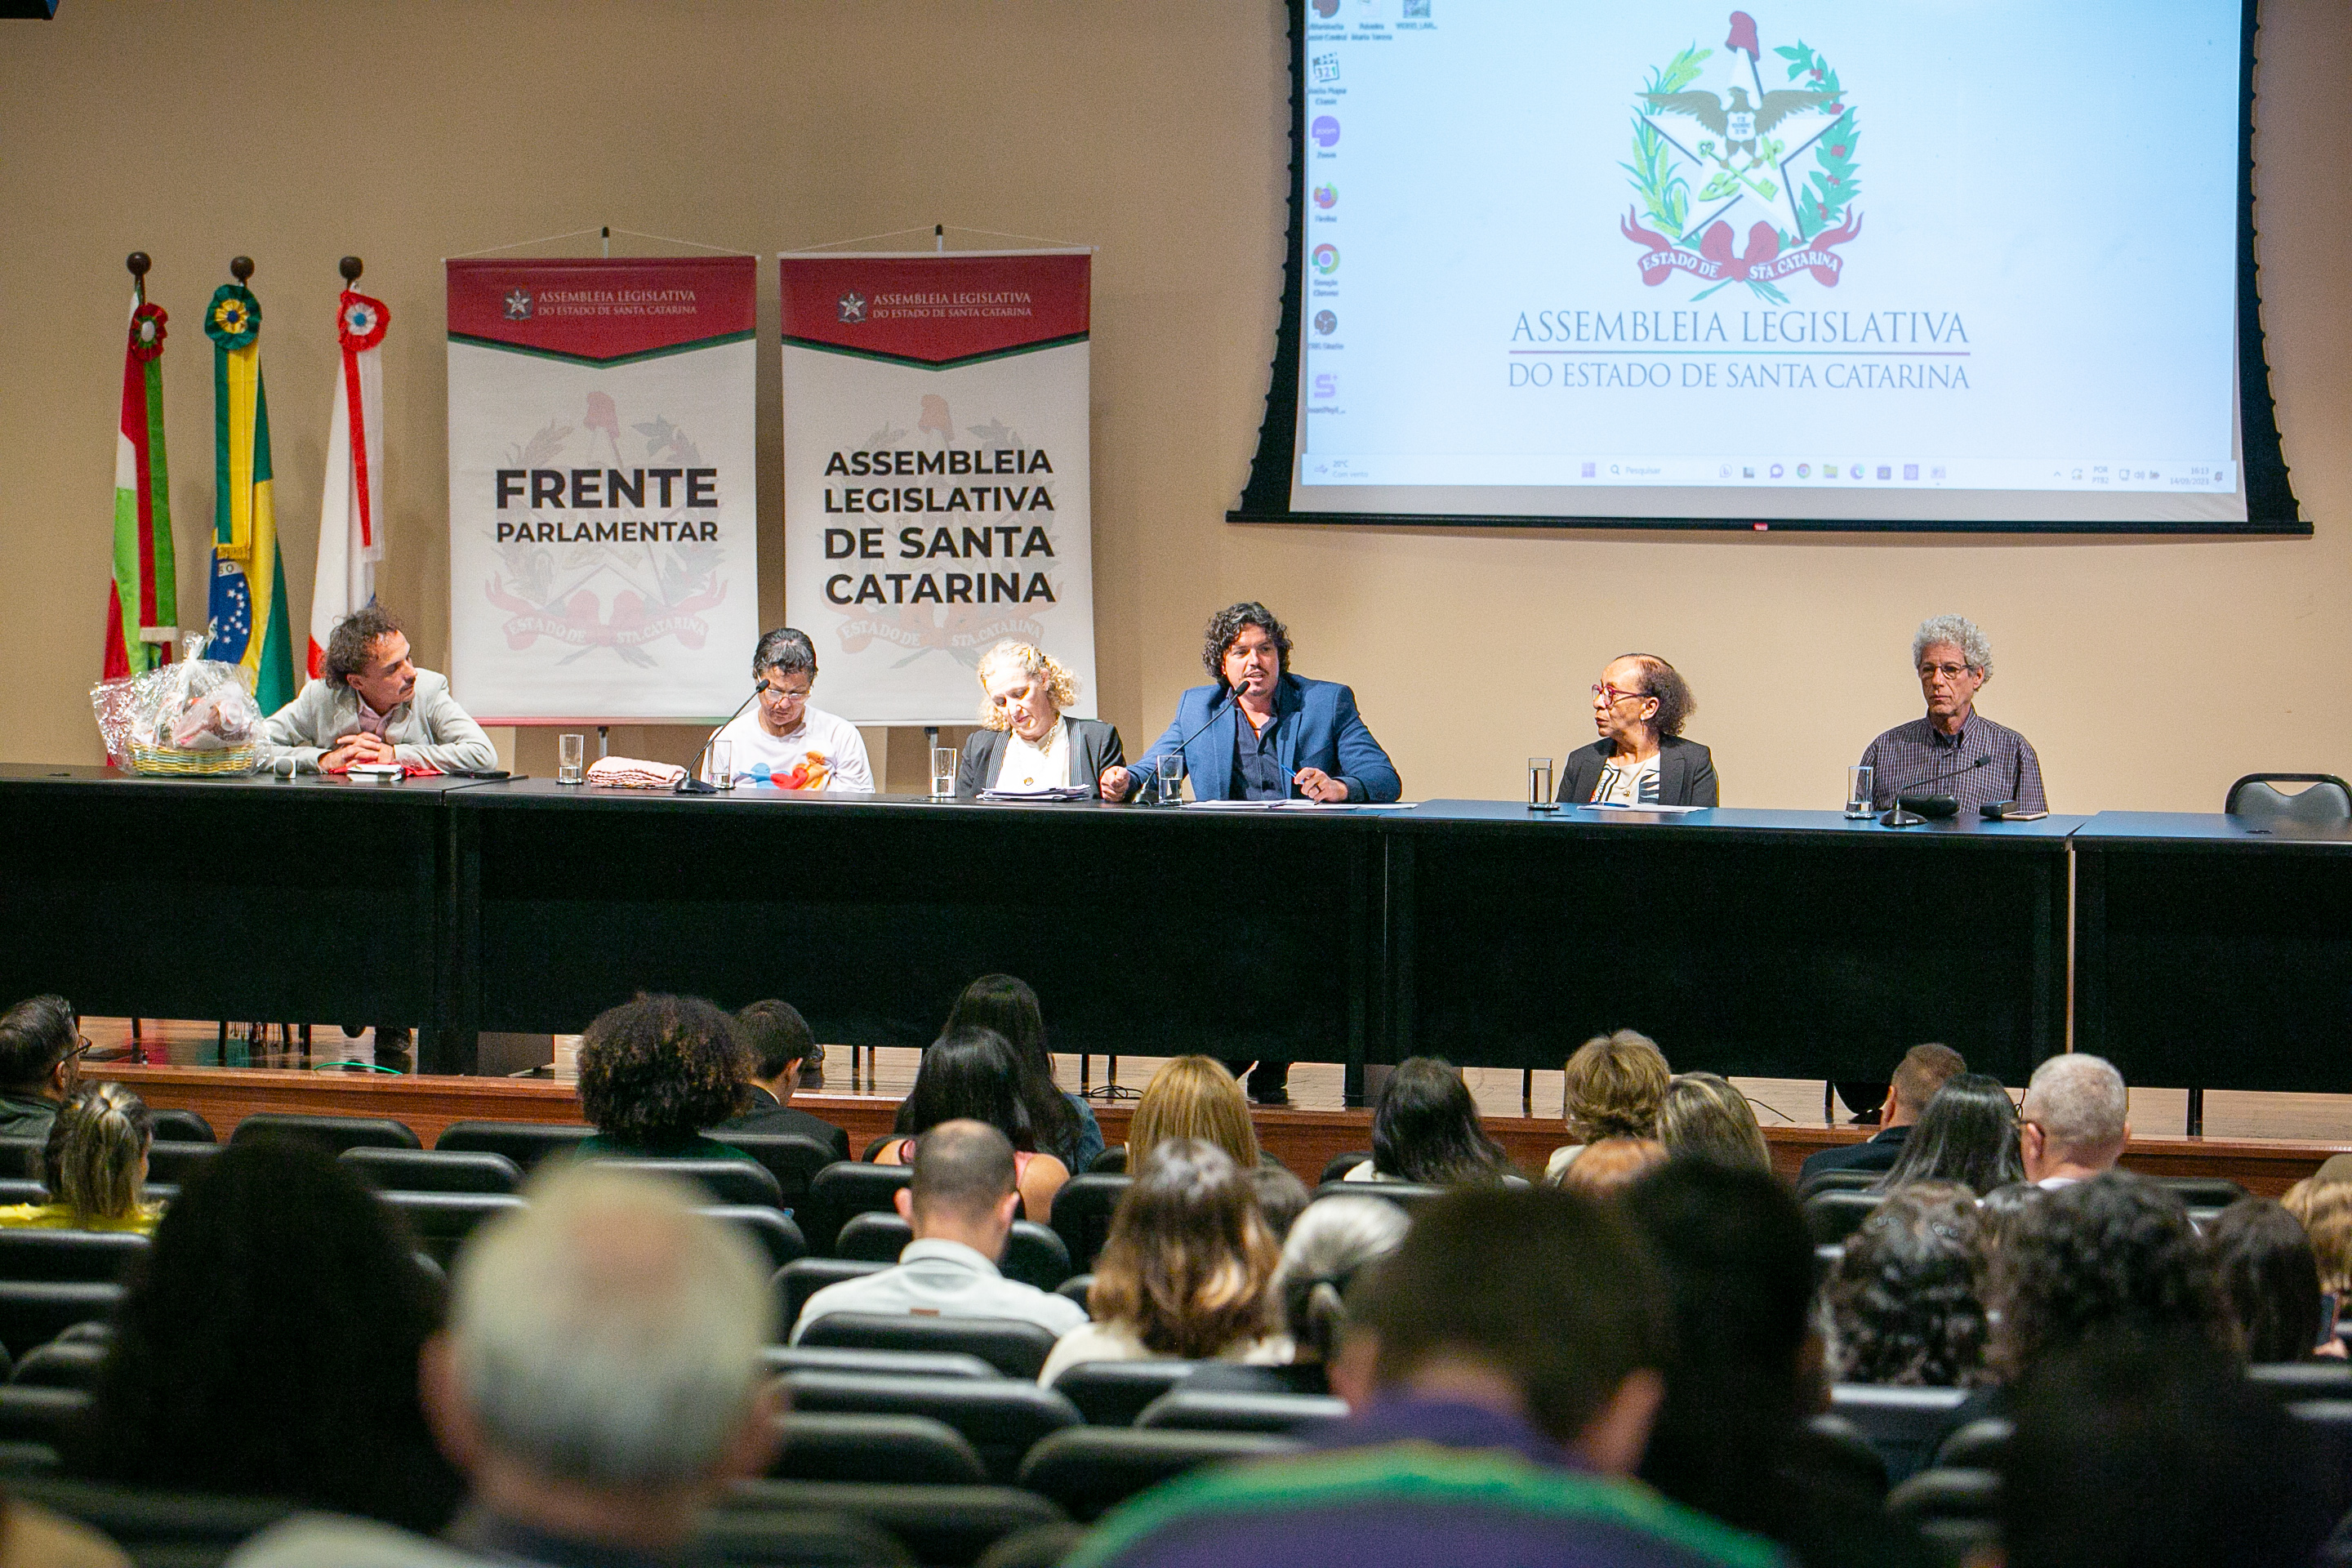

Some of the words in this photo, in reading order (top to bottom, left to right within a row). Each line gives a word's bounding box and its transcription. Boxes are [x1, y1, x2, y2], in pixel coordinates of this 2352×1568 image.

[1642, 252, 1696, 271] ESTADO
[1699, 261, 1718, 278] DE
[538, 291, 613, 302] ASSEMBLEIA
[617, 290, 696, 301] LEGISLATIVA
[873, 293, 948, 305] ASSEMBLEIA
[952, 292, 1031, 304] LEGISLATIVA
[538, 306, 555, 315] DO
[557, 306, 595, 315] ESTADO
[597, 306, 610, 314] DE
[613, 305, 646, 314] SANTA
[647, 305, 697, 314] CATARINA
[873, 310, 889, 318] DO
[891, 309, 929, 318] ESTADO
[932, 309, 946, 317] DE
[948, 308, 979, 317] SANTA
[981, 307, 1031, 316] CATARINA
[1511, 310, 1729, 343] ASSEMBLEIA
[1742, 310, 1970, 344] LEGISLATIVA
[1508, 363, 1553, 388] DO
[1563, 363, 1671, 388] ESTADO
[1681, 363, 1717, 388] DE
[1726, 363, 1818, 389] SANTA
[1824, 363, 1971, 390] CATARINA
[824, 449, 1054, 476] ASSEMBLEIA
[497, 468, 718, 509] FRENTE
[824, 487, 1054, 514] LEGISLATIVA
[497, 522, 718, 542] PARLAMENTAR
[825, 528, 884, 559] DE
[899, 526, 1054, 559] SANTA
[826, 572, 1056, 605] CATARINA
[510, 617, 566, 636] ESTADO
[566, 629, 586, 643] DE
[842, 621, 898, 639] ESTADO
[900, 631, 920, 646] DE
